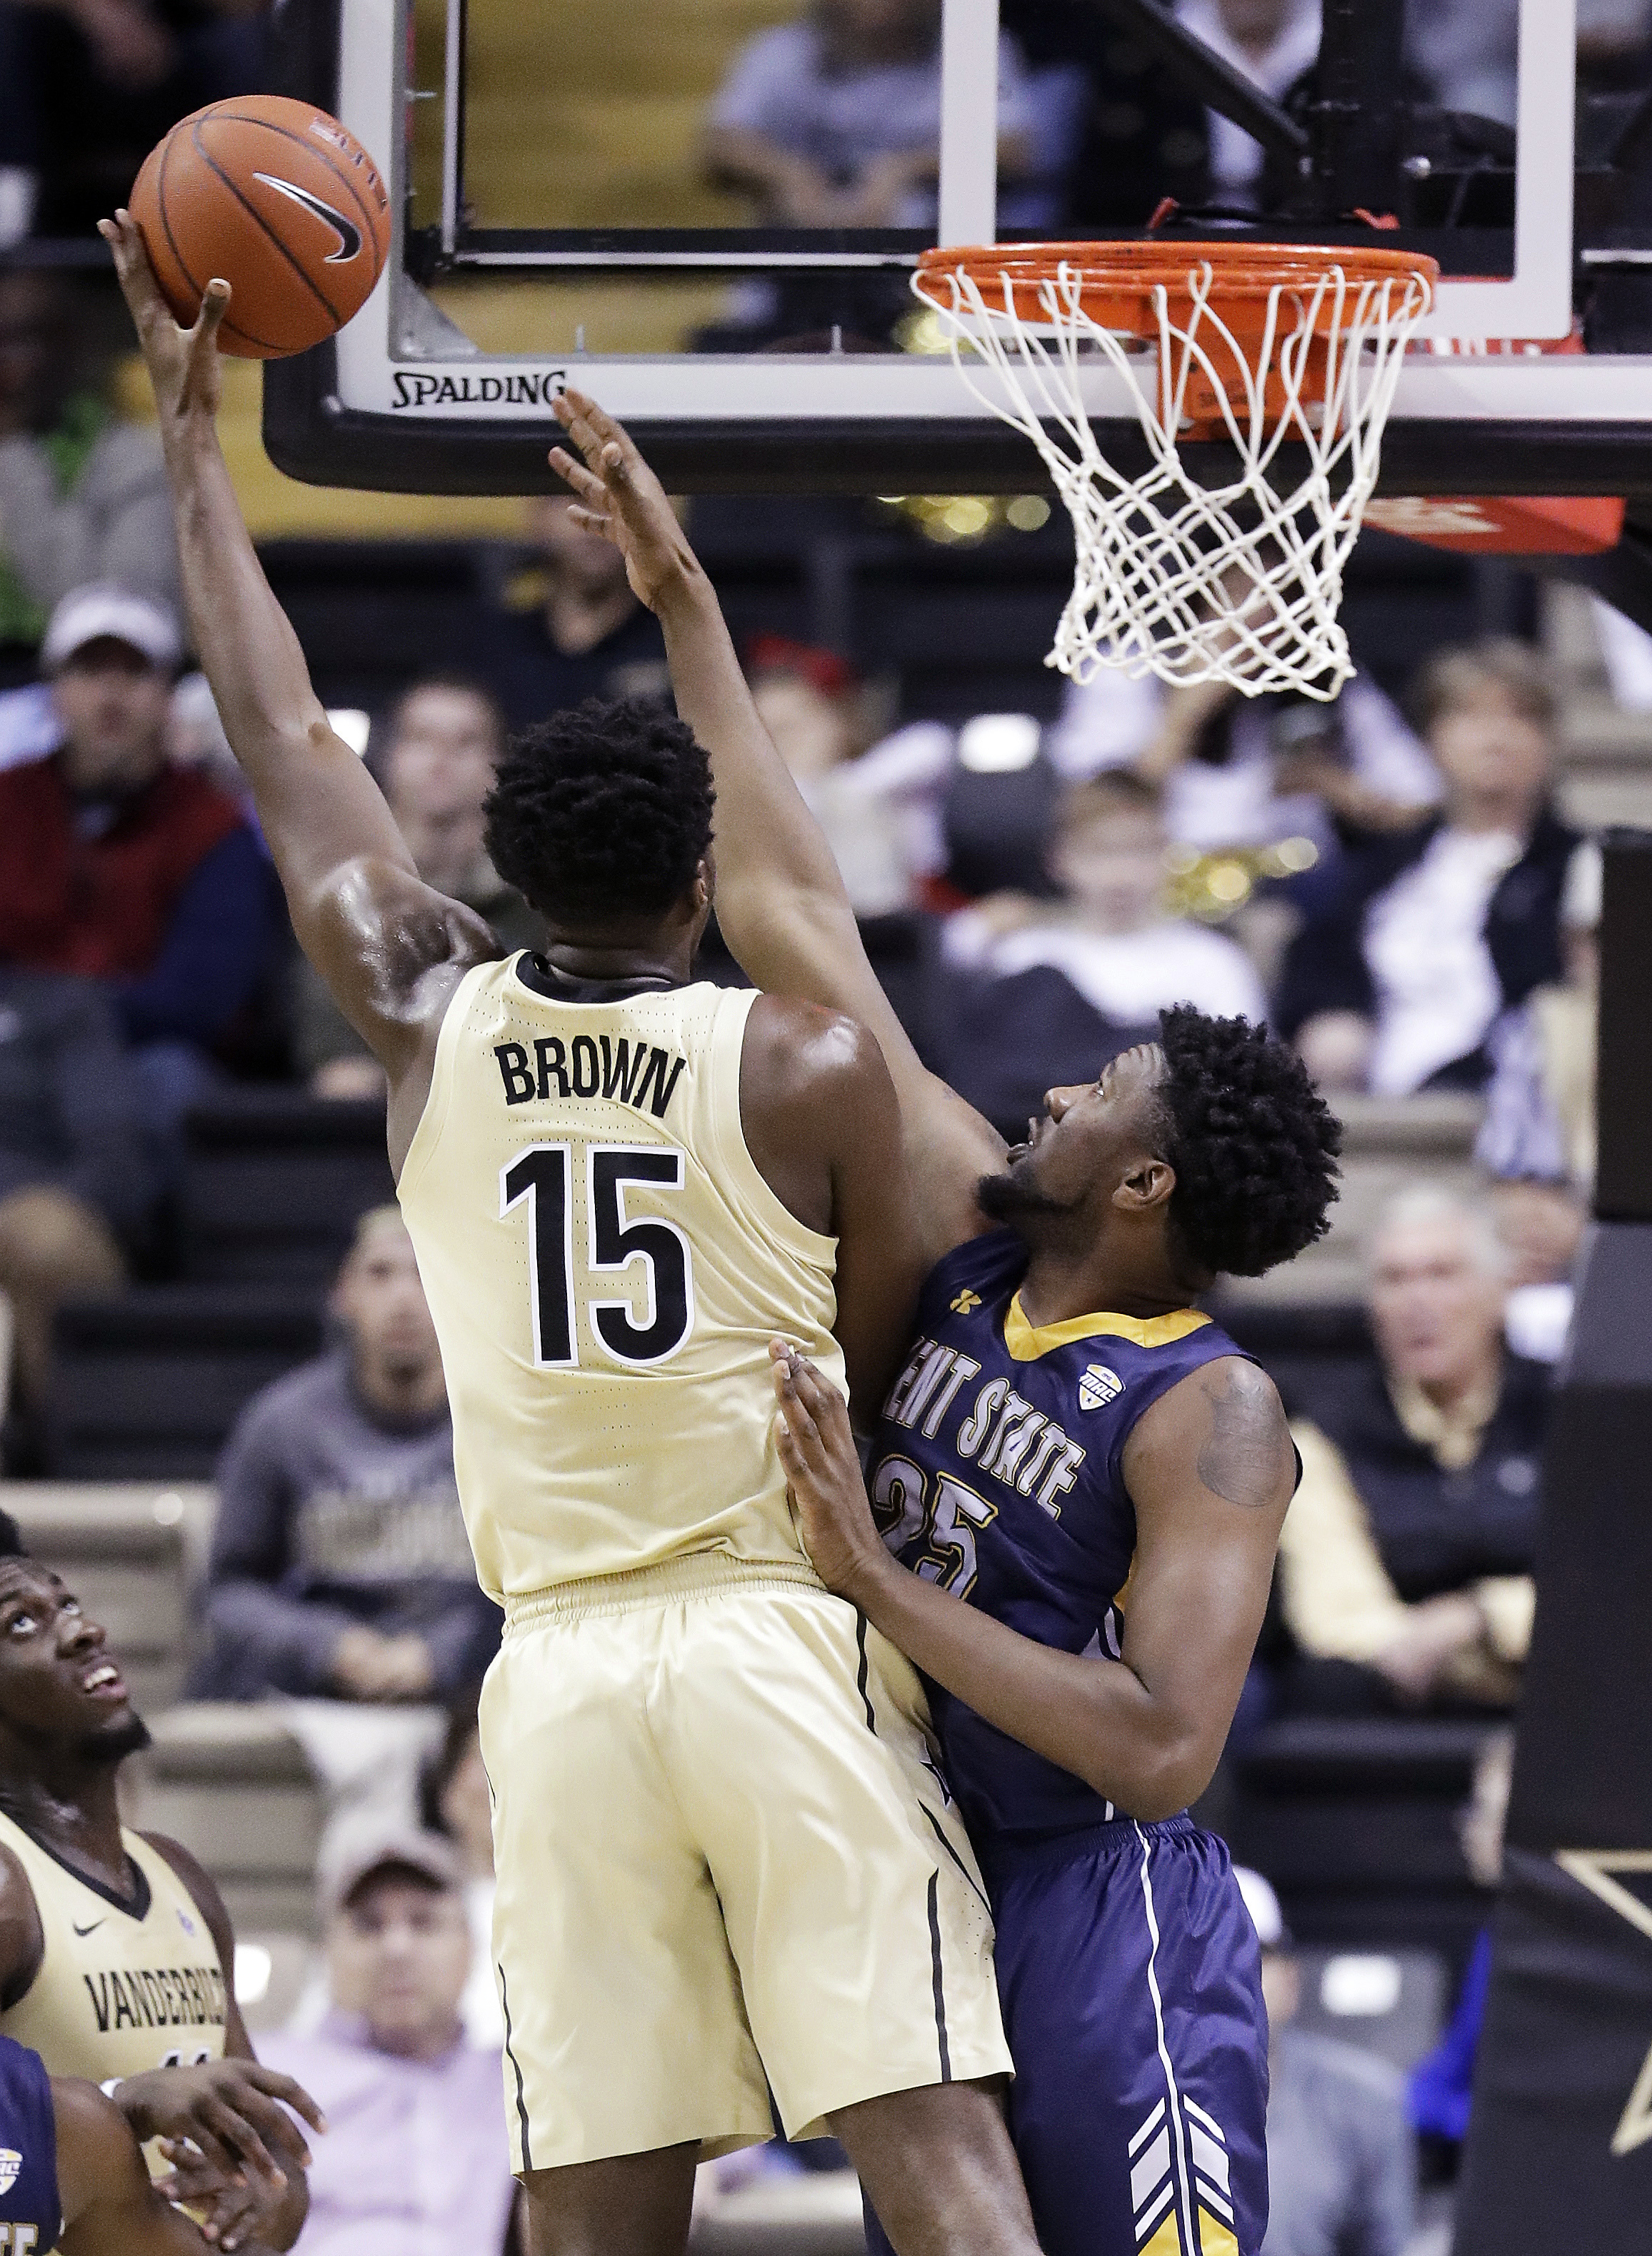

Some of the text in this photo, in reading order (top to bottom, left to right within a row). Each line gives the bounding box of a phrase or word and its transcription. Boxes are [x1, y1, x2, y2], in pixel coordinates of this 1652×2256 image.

[391, 370, 566, 408] SPALDING
[494, 1035, 686, 1118] BROWN
[499, 1142, 696, 1368] 15
[881, 1335, 1086, 1521] ENT STATE
[1078, 1372, 1117, 1403] MAC
[873, 1453, 998, 1602] 25
